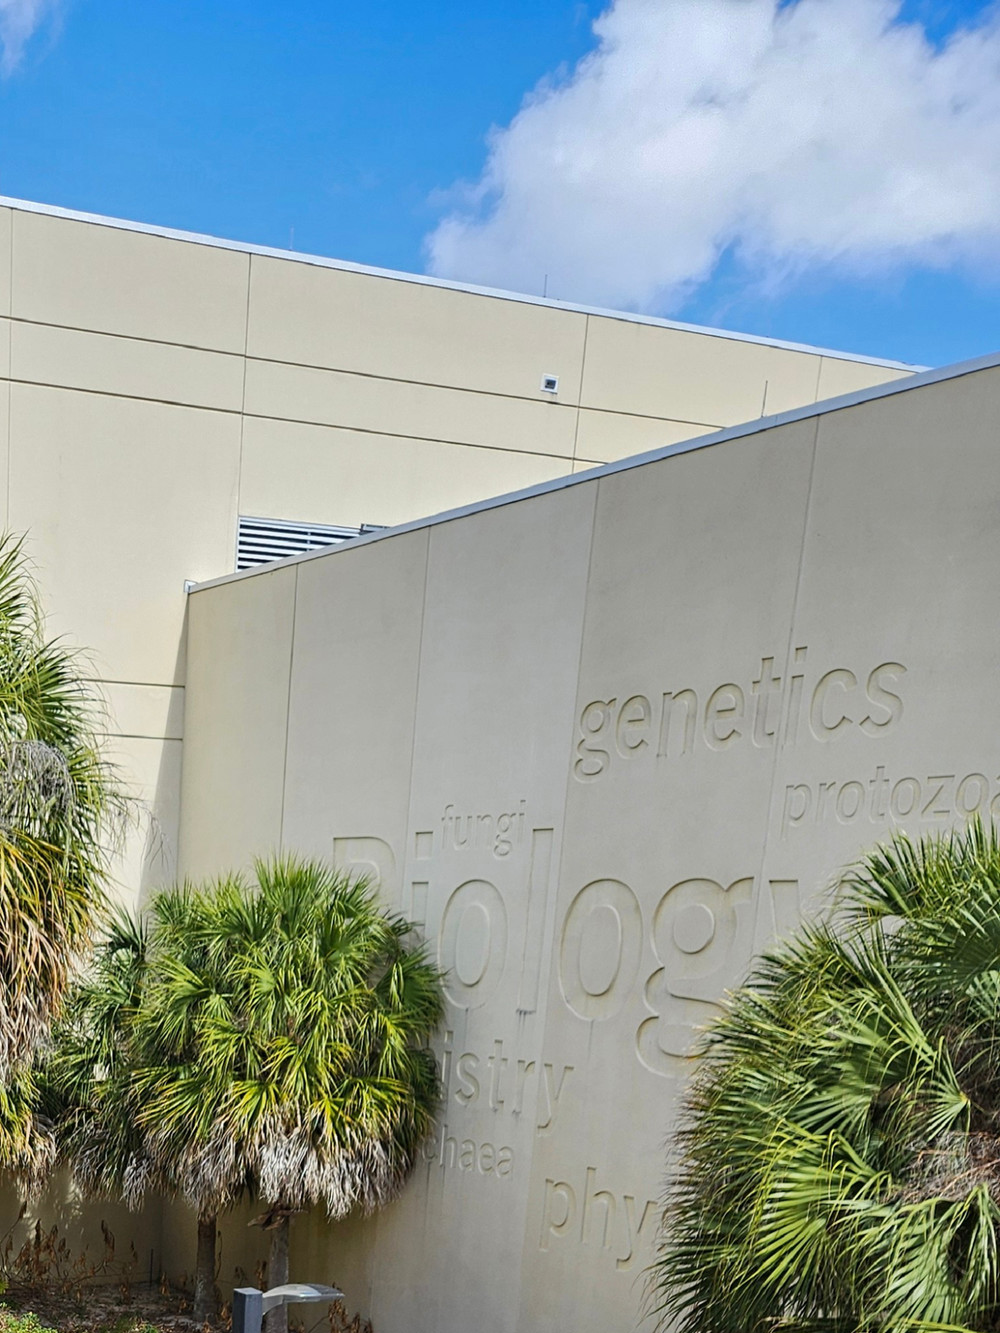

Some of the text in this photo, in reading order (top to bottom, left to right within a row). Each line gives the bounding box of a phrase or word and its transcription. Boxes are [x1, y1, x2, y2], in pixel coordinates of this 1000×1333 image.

[573, 646, 908, 783] genetics
[441, 800, 526, 858] fungi
[440, 1030, 575, 1137] istry
[422, 1124, 514, 1179] chaea
[539, 1166, 675, 1271] phy
